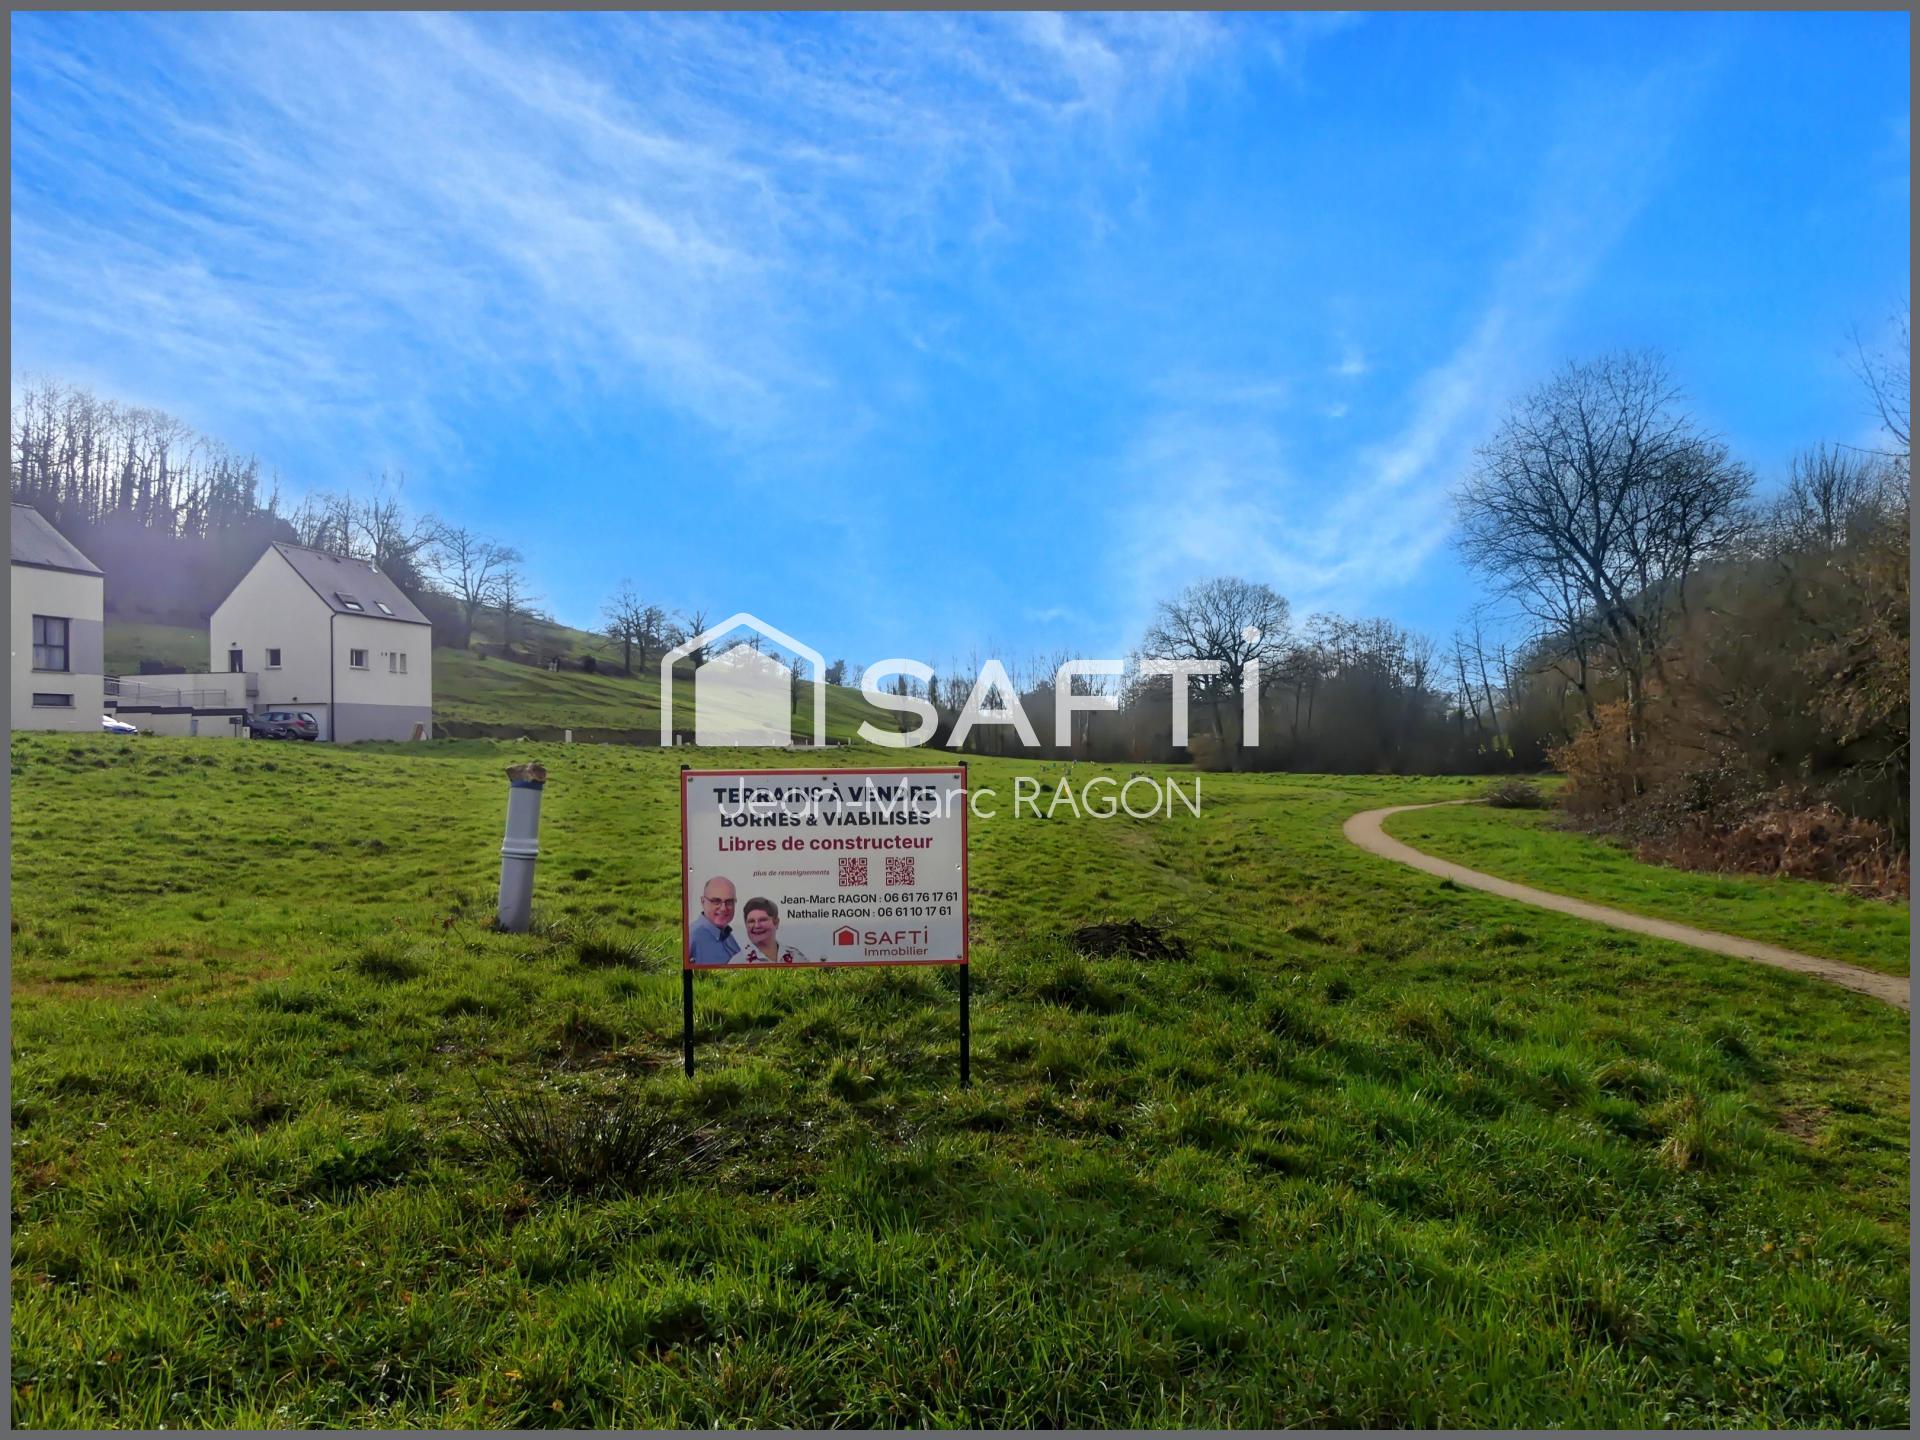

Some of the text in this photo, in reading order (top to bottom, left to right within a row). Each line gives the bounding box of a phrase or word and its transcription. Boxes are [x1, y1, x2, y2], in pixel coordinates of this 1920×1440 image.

[713, 786, 823, 803] TERRAINS
[848, 785, 936, 803] VENDRE
[806, 813, 818, 827] &
[719, 835, 933, 852] Libres de constructeur
[778, 869, 830, 877] renseignements
[780, 895, 836, 905] Jean-Marc
[838, 894, 877, 904] RAGON
[884, 893, 899, 903] 06
[901, 892, 914, 903] 61
[915, 892, 930, 902] 76
[931, 892, 943, 902] 17
[945, 892, 958, 902] 61
[787, 909, 829, 919] Nathalie
[831, 908, 870, 918] RAGON
[877, 907, 893, 917] 06
[895, 907, 908, 917] 61
[910, 907, 922, 916] 10
[926, 907, 937, 916] 17
[939, 906, 952, 916] 61
